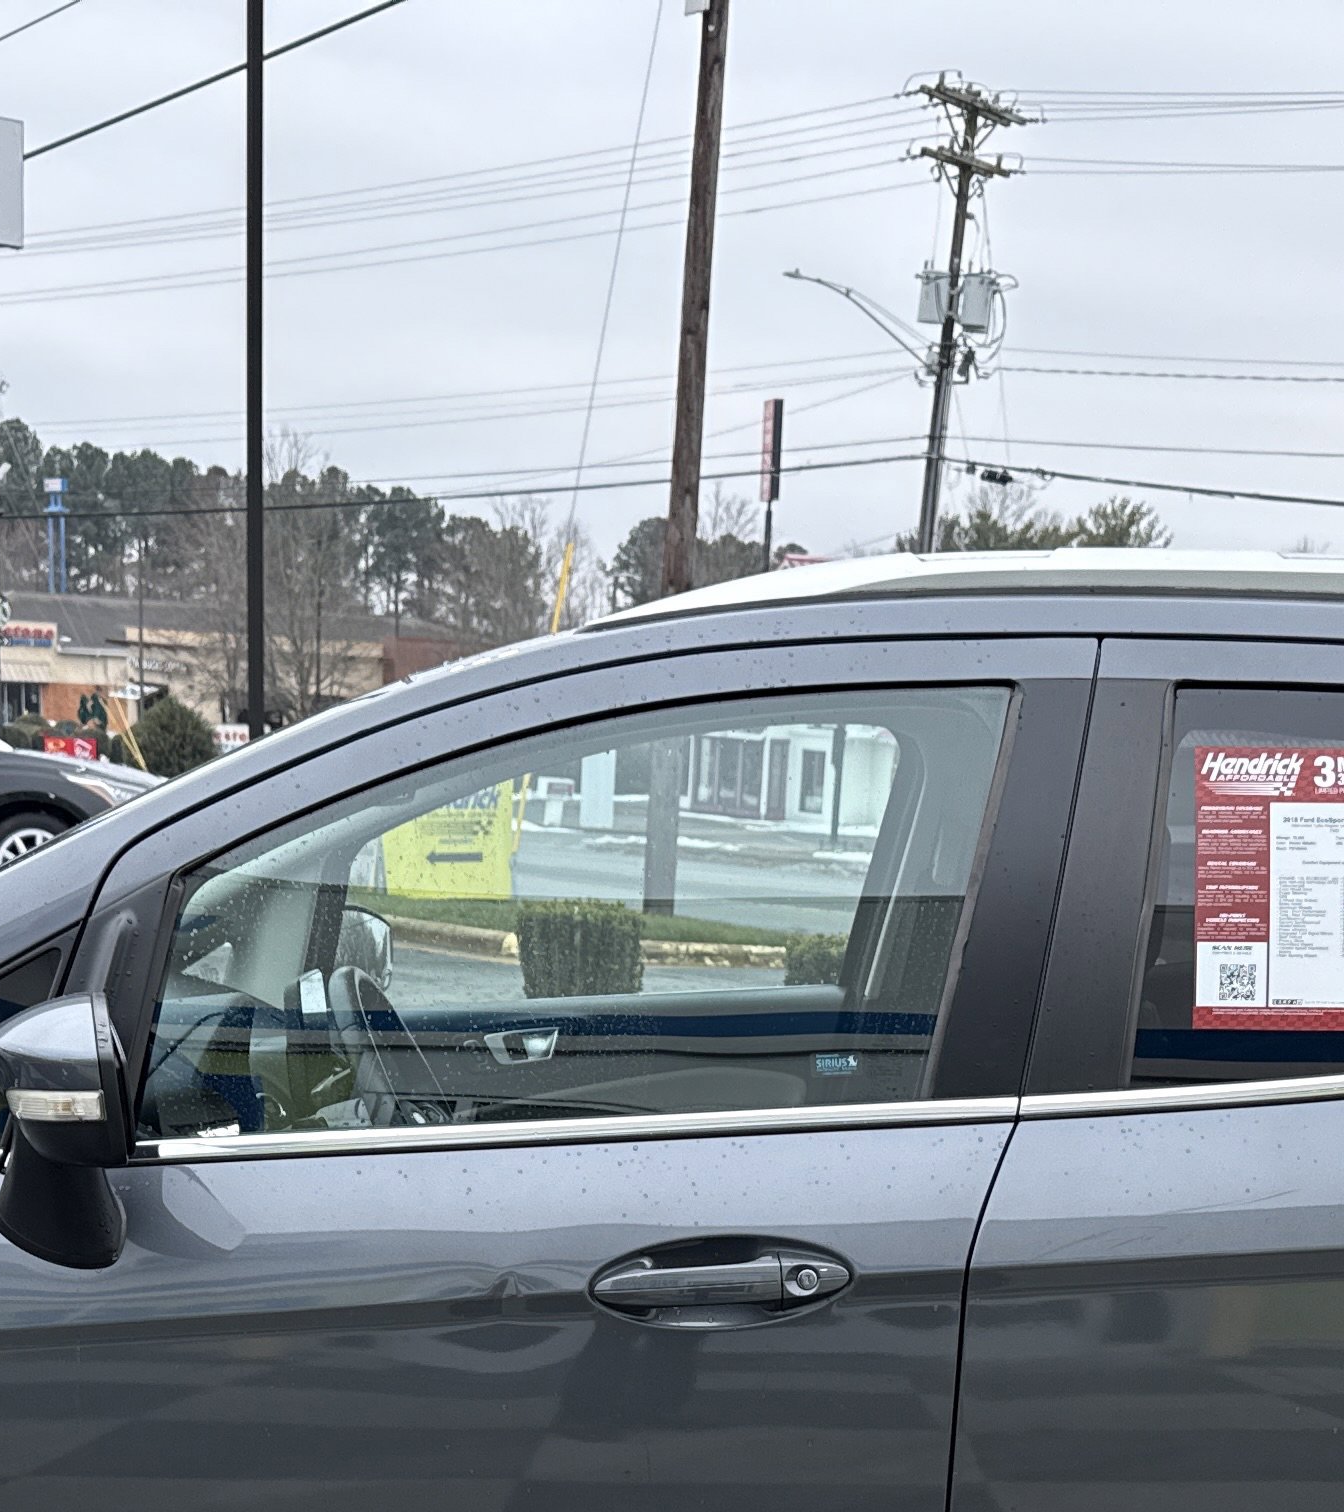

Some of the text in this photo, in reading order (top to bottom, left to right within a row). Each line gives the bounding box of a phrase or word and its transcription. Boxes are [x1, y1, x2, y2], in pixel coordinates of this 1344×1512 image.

[1201, 751, 1305, 782] Hendrick
[1313, 755, 1336, 788] 3
[1216, 774, 1298, 782] AFFORDABLE
[815, 1058, 849, 1068] SIRIUS
